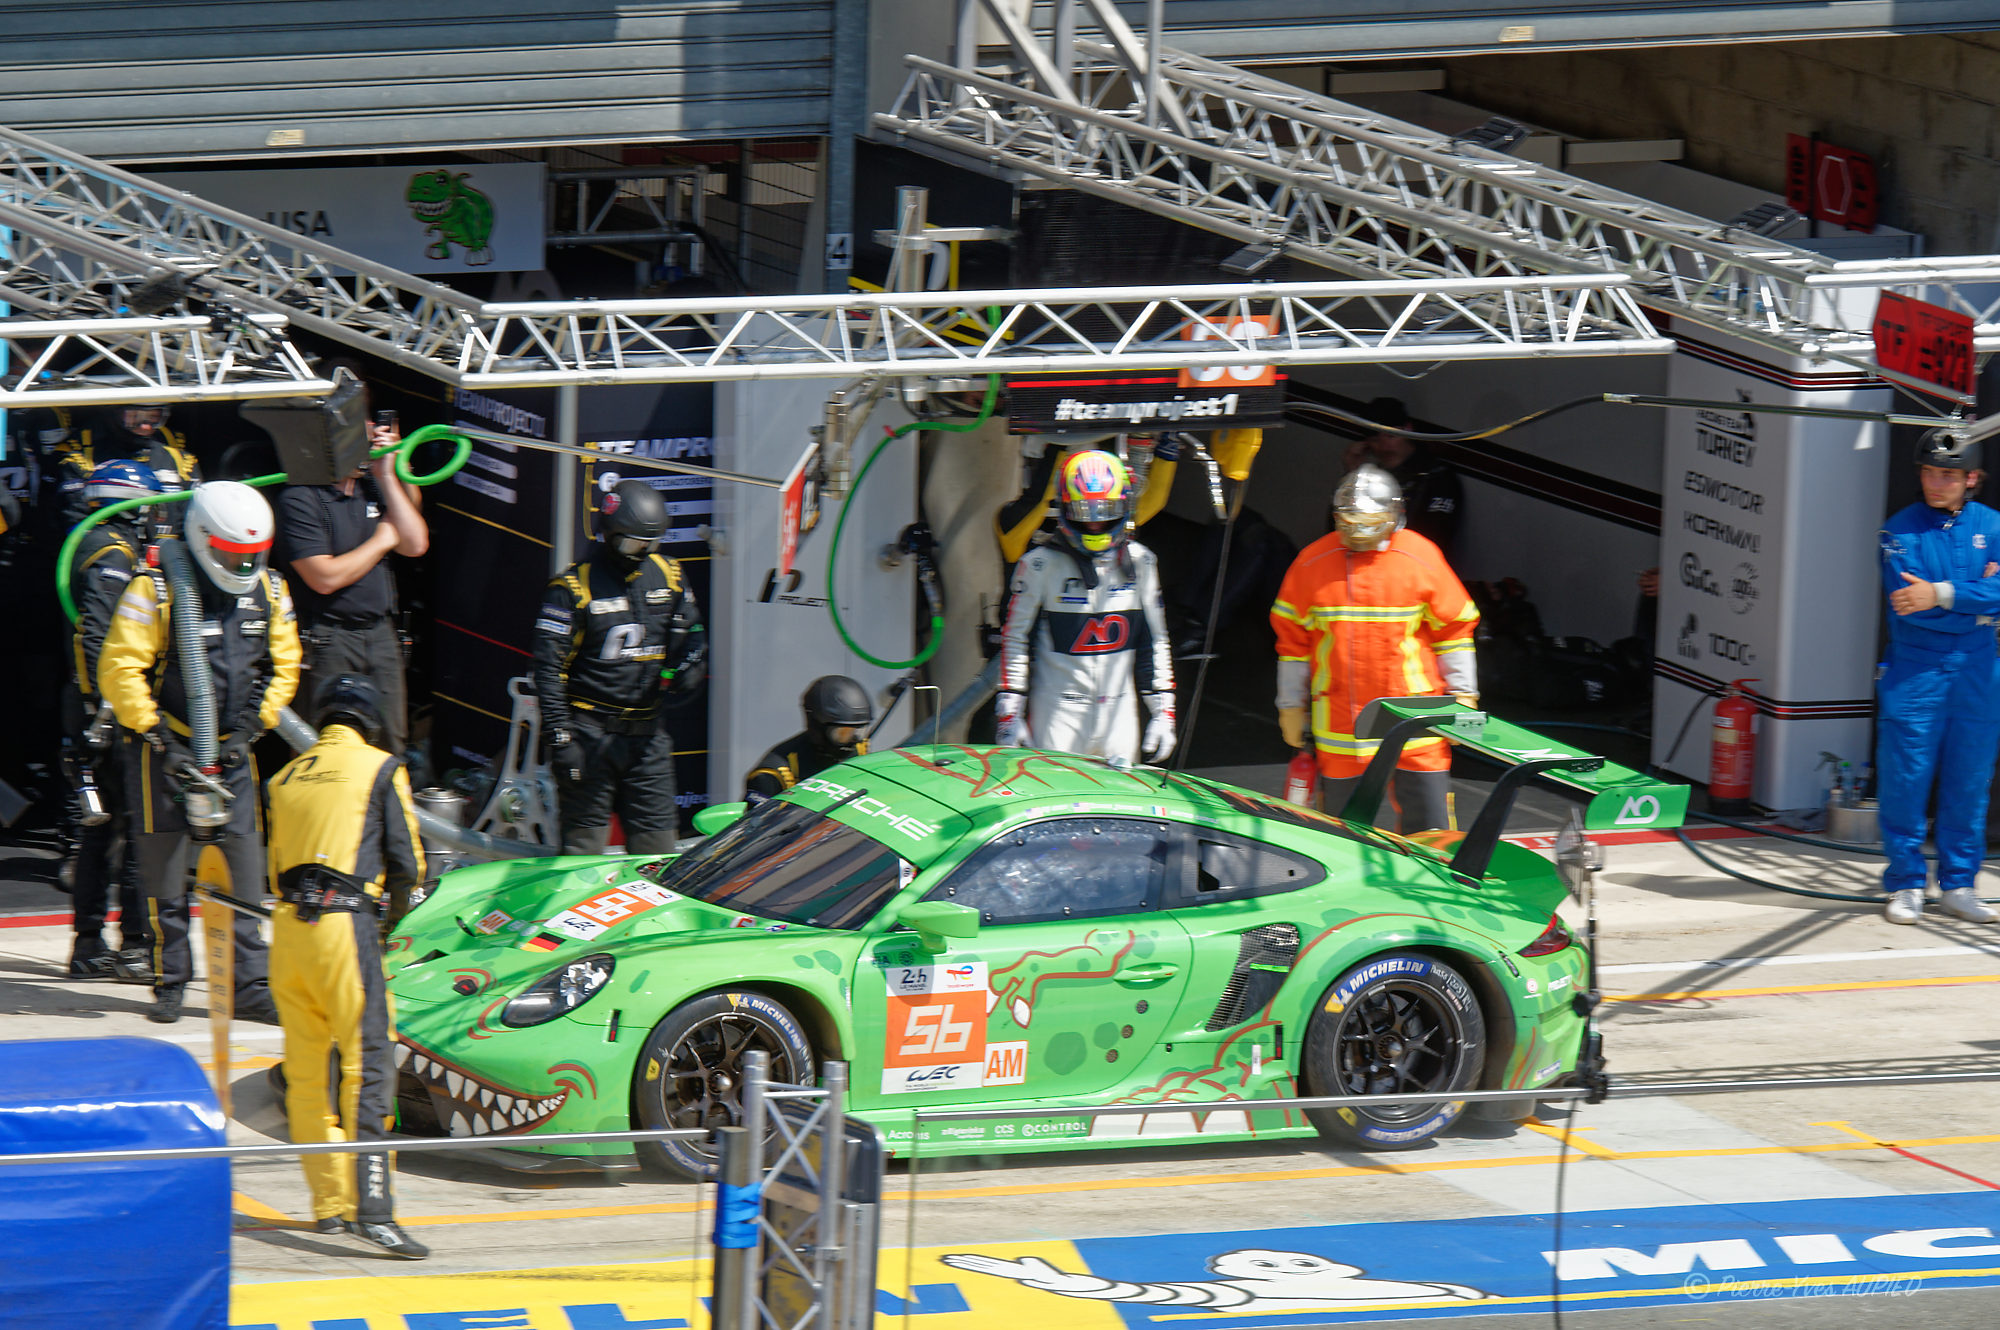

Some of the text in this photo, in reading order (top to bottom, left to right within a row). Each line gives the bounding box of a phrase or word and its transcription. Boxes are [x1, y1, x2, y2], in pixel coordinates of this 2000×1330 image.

[1054, 393, 1240, 424] #teamproject1
[1349, 960, 1425, 992] MICHELIN
[751, 999, 803, 1050] MICHELIN
[898, 1003, 974, 1056] 56
[906, 1065, 962, 1082] WEC
[985, 1048, 1025, 1080] AM
